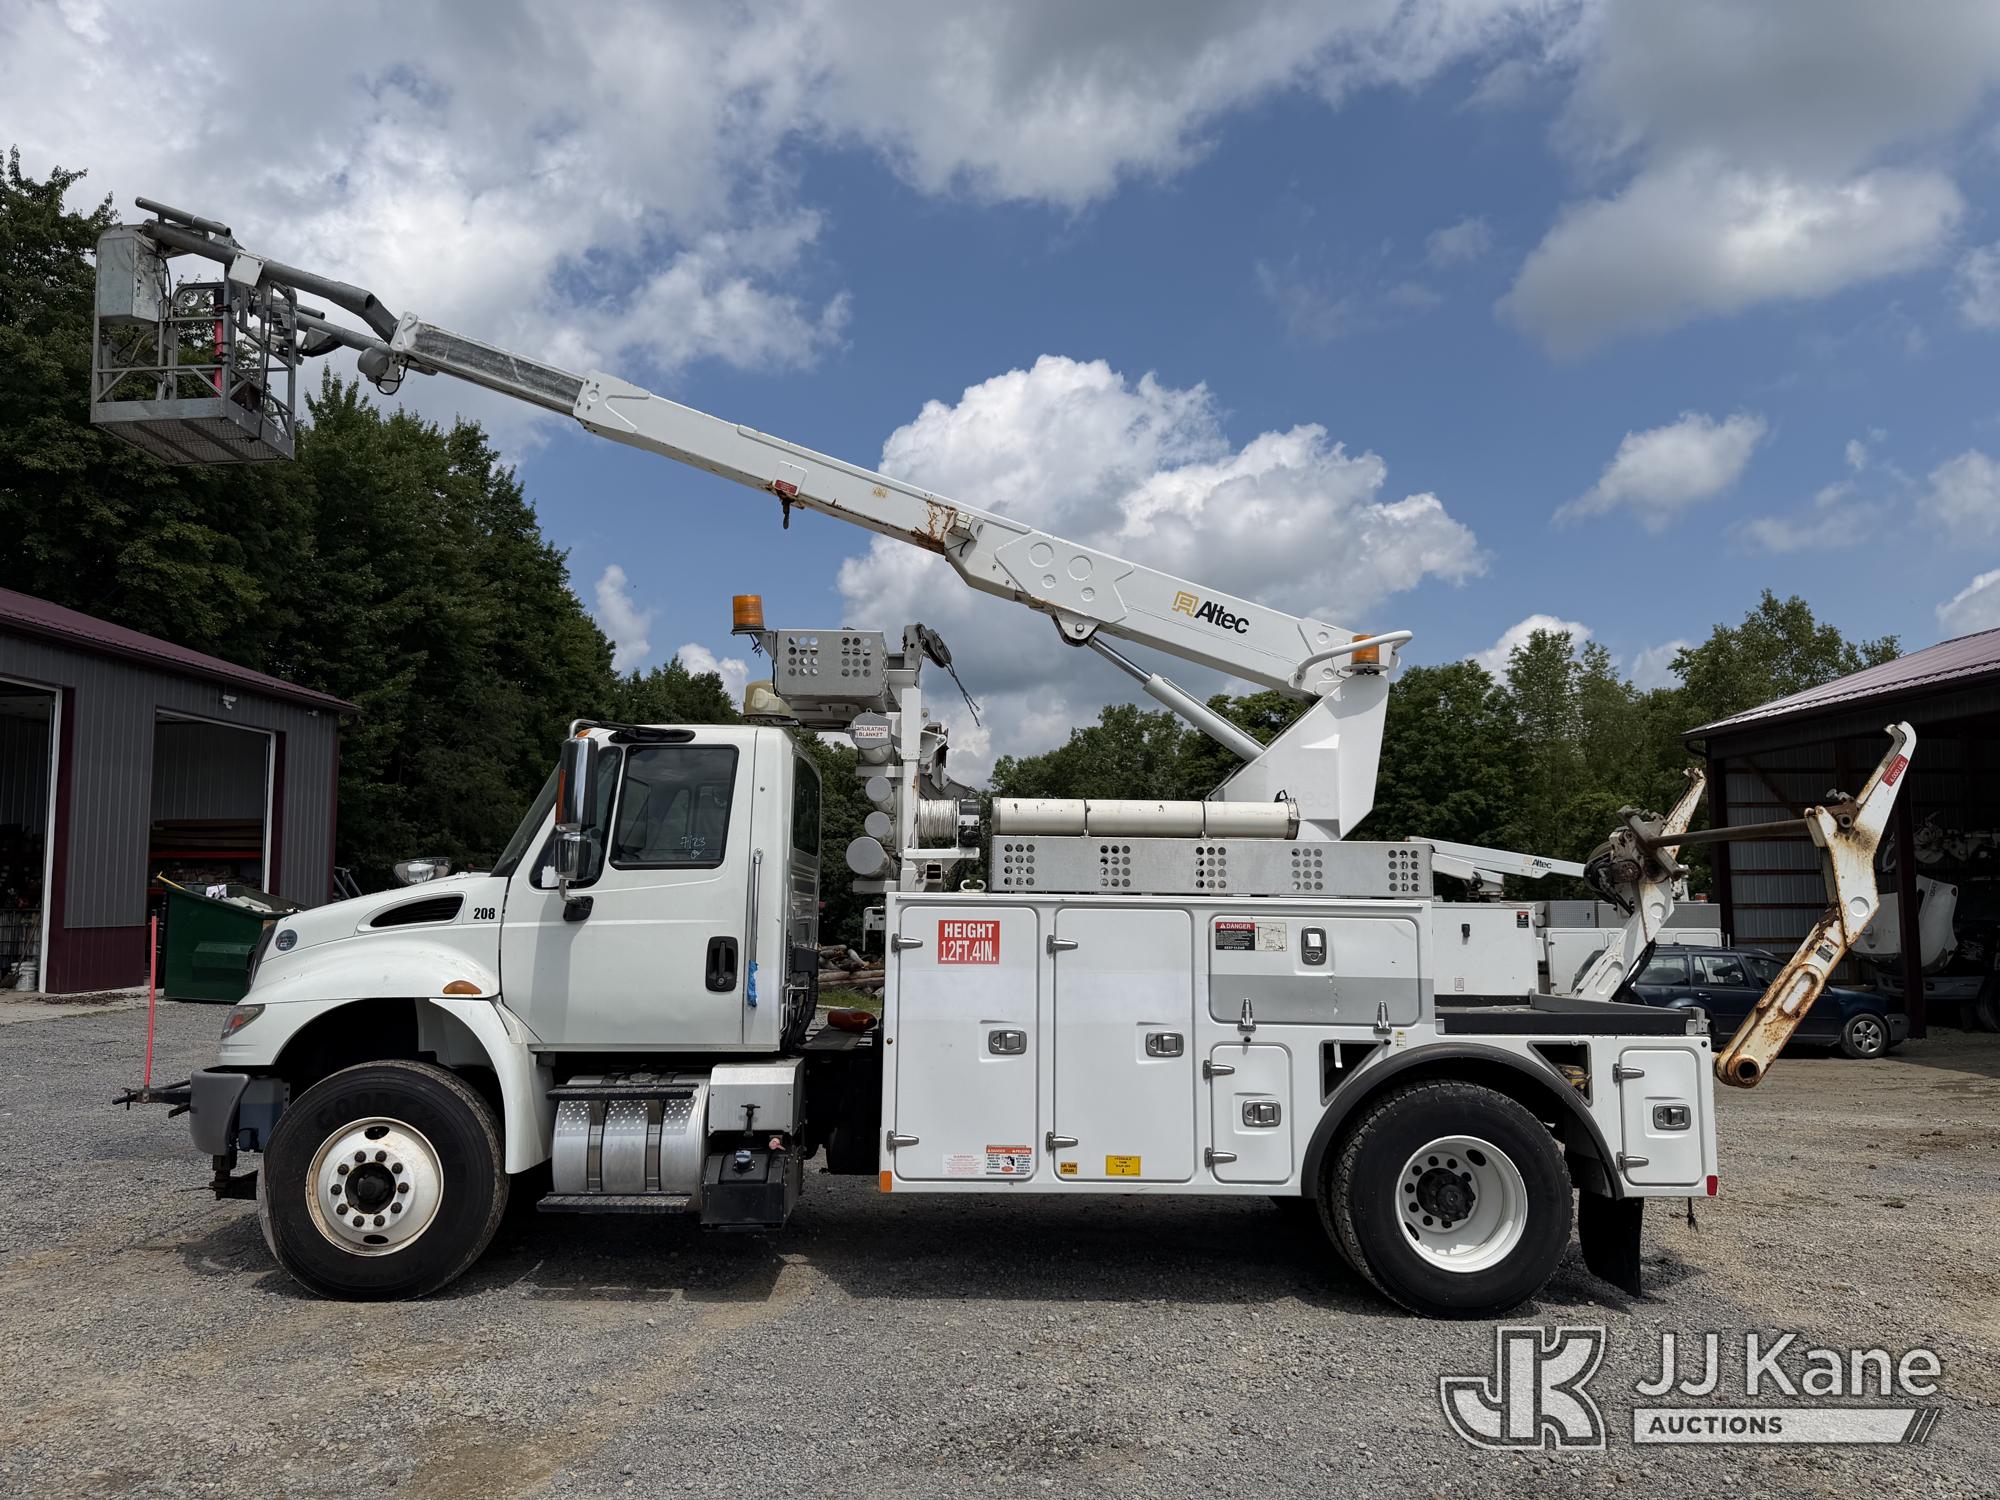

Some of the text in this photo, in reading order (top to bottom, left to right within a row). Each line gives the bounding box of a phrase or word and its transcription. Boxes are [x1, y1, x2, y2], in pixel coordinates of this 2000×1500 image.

[1194, 600, 1250, 634] Altec
[1532, 858, 1552, 869] Altec
[473, 907, 496, 920] 208
[944, 923, 995, 938] HEIGHT
[941, 940, 996, 962] 12FT.4IN.
